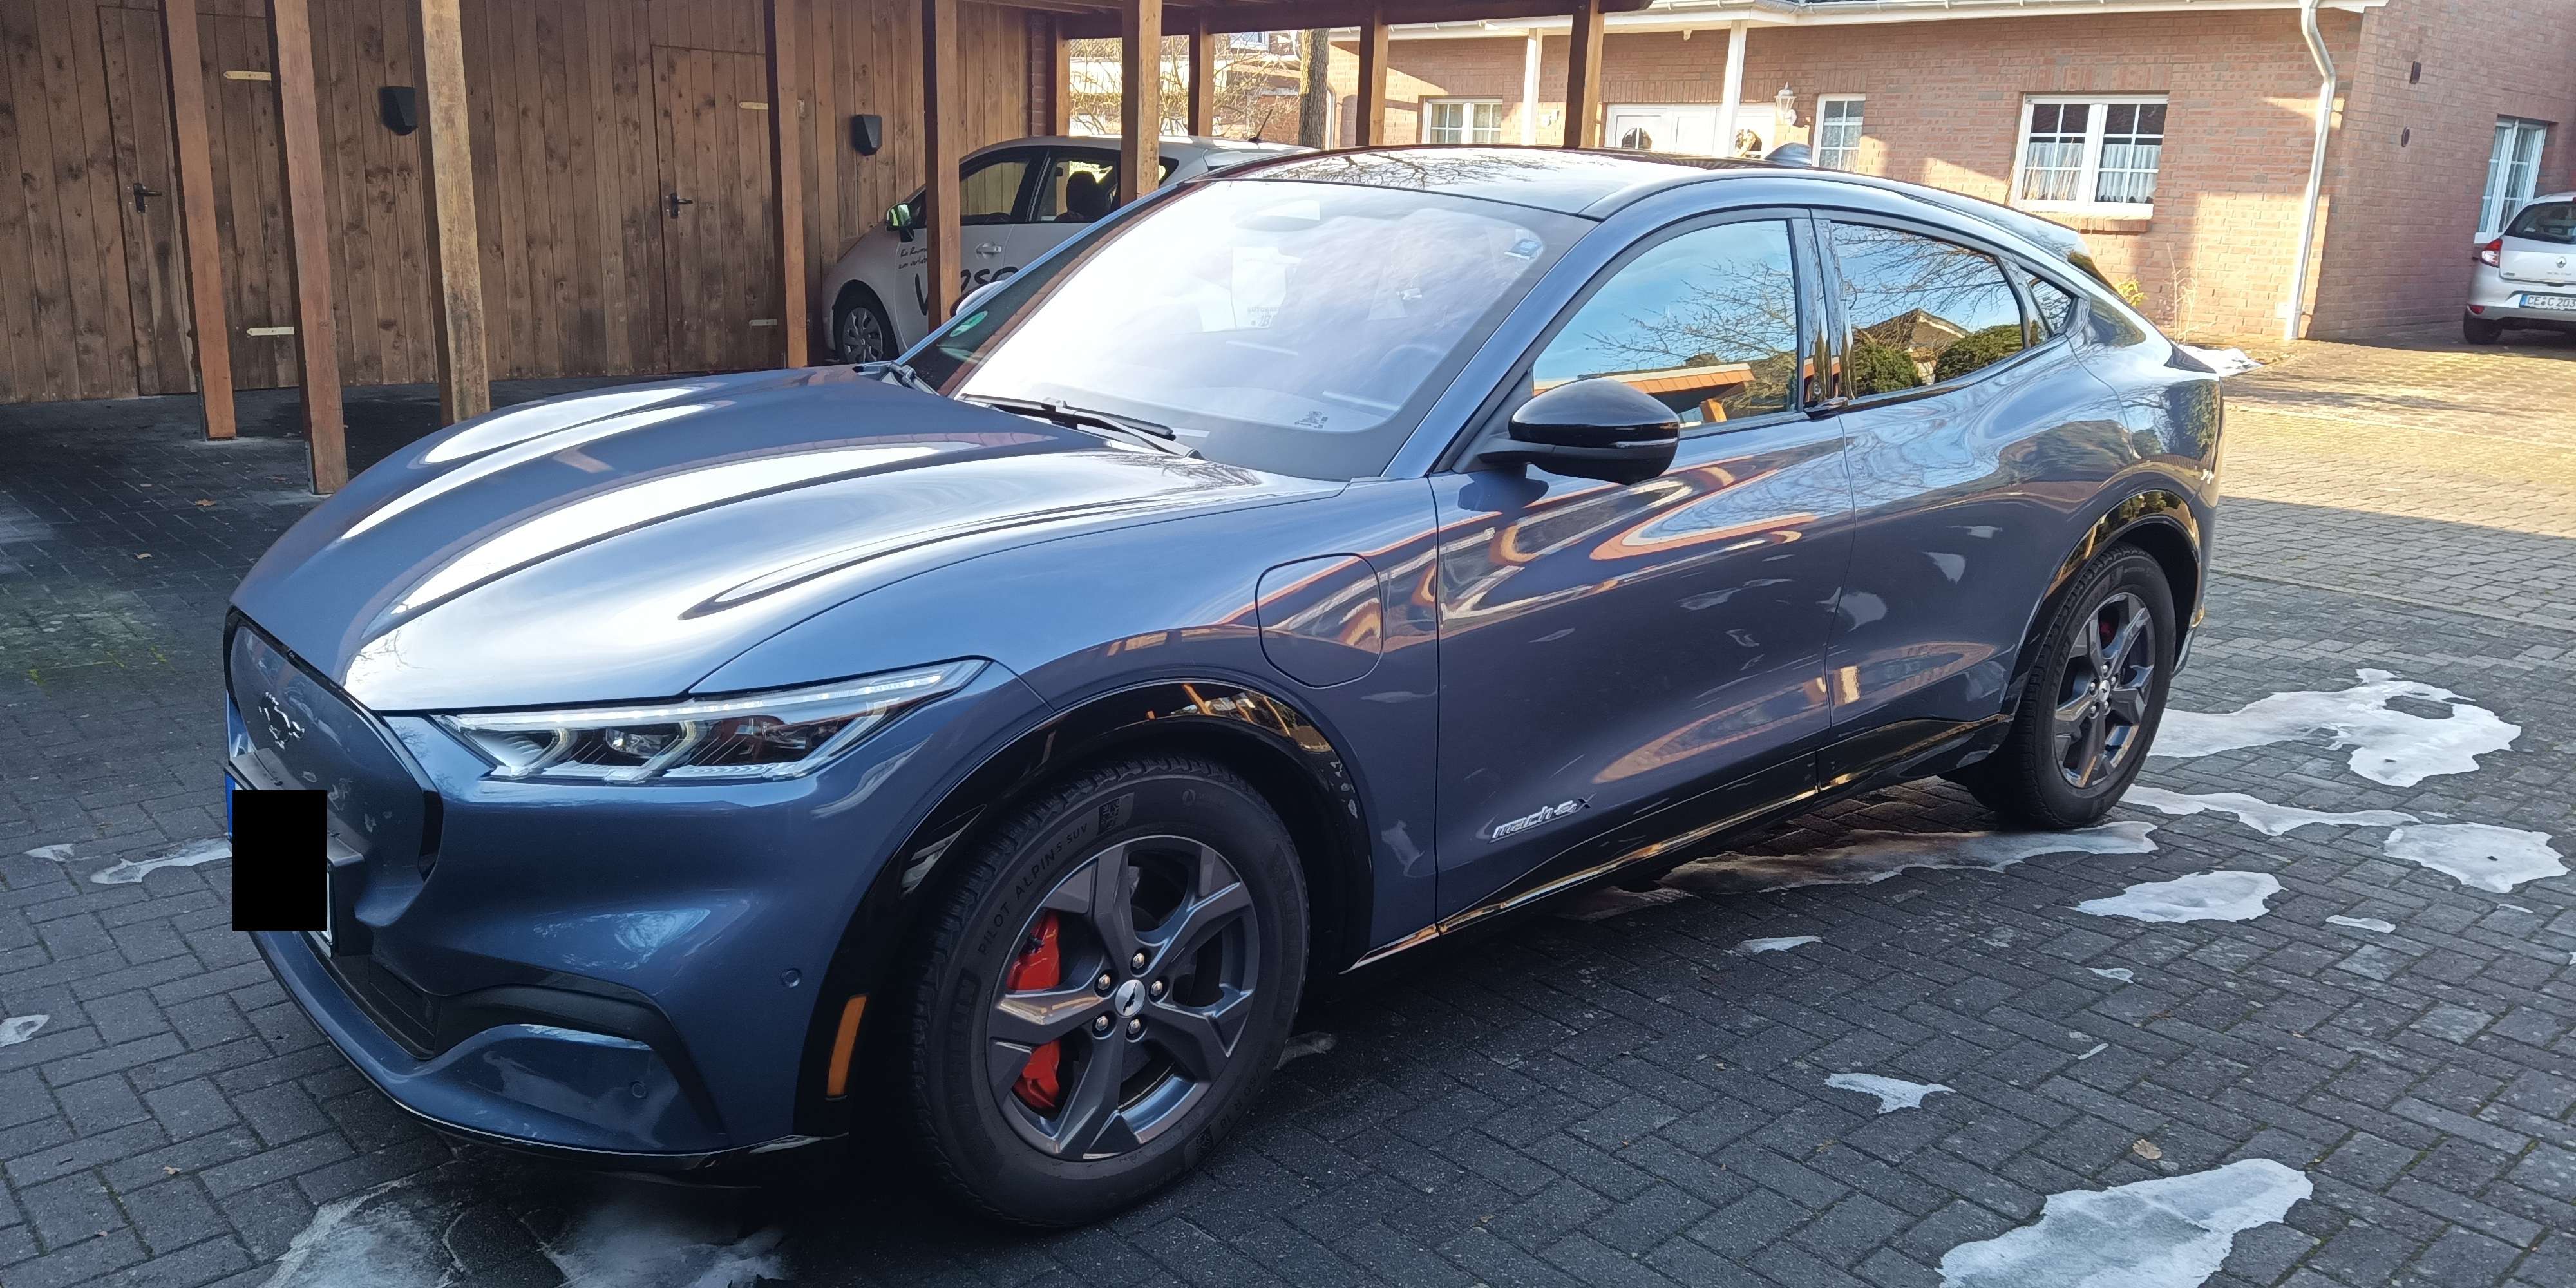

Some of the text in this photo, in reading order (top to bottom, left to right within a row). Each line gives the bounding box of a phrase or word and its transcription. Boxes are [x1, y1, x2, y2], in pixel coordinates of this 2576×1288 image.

[978, 902, 1010, 955] PILOT
[1014, 849, 1056, 900] ALPIN
[1067, 823, 1088, 844] SUV
